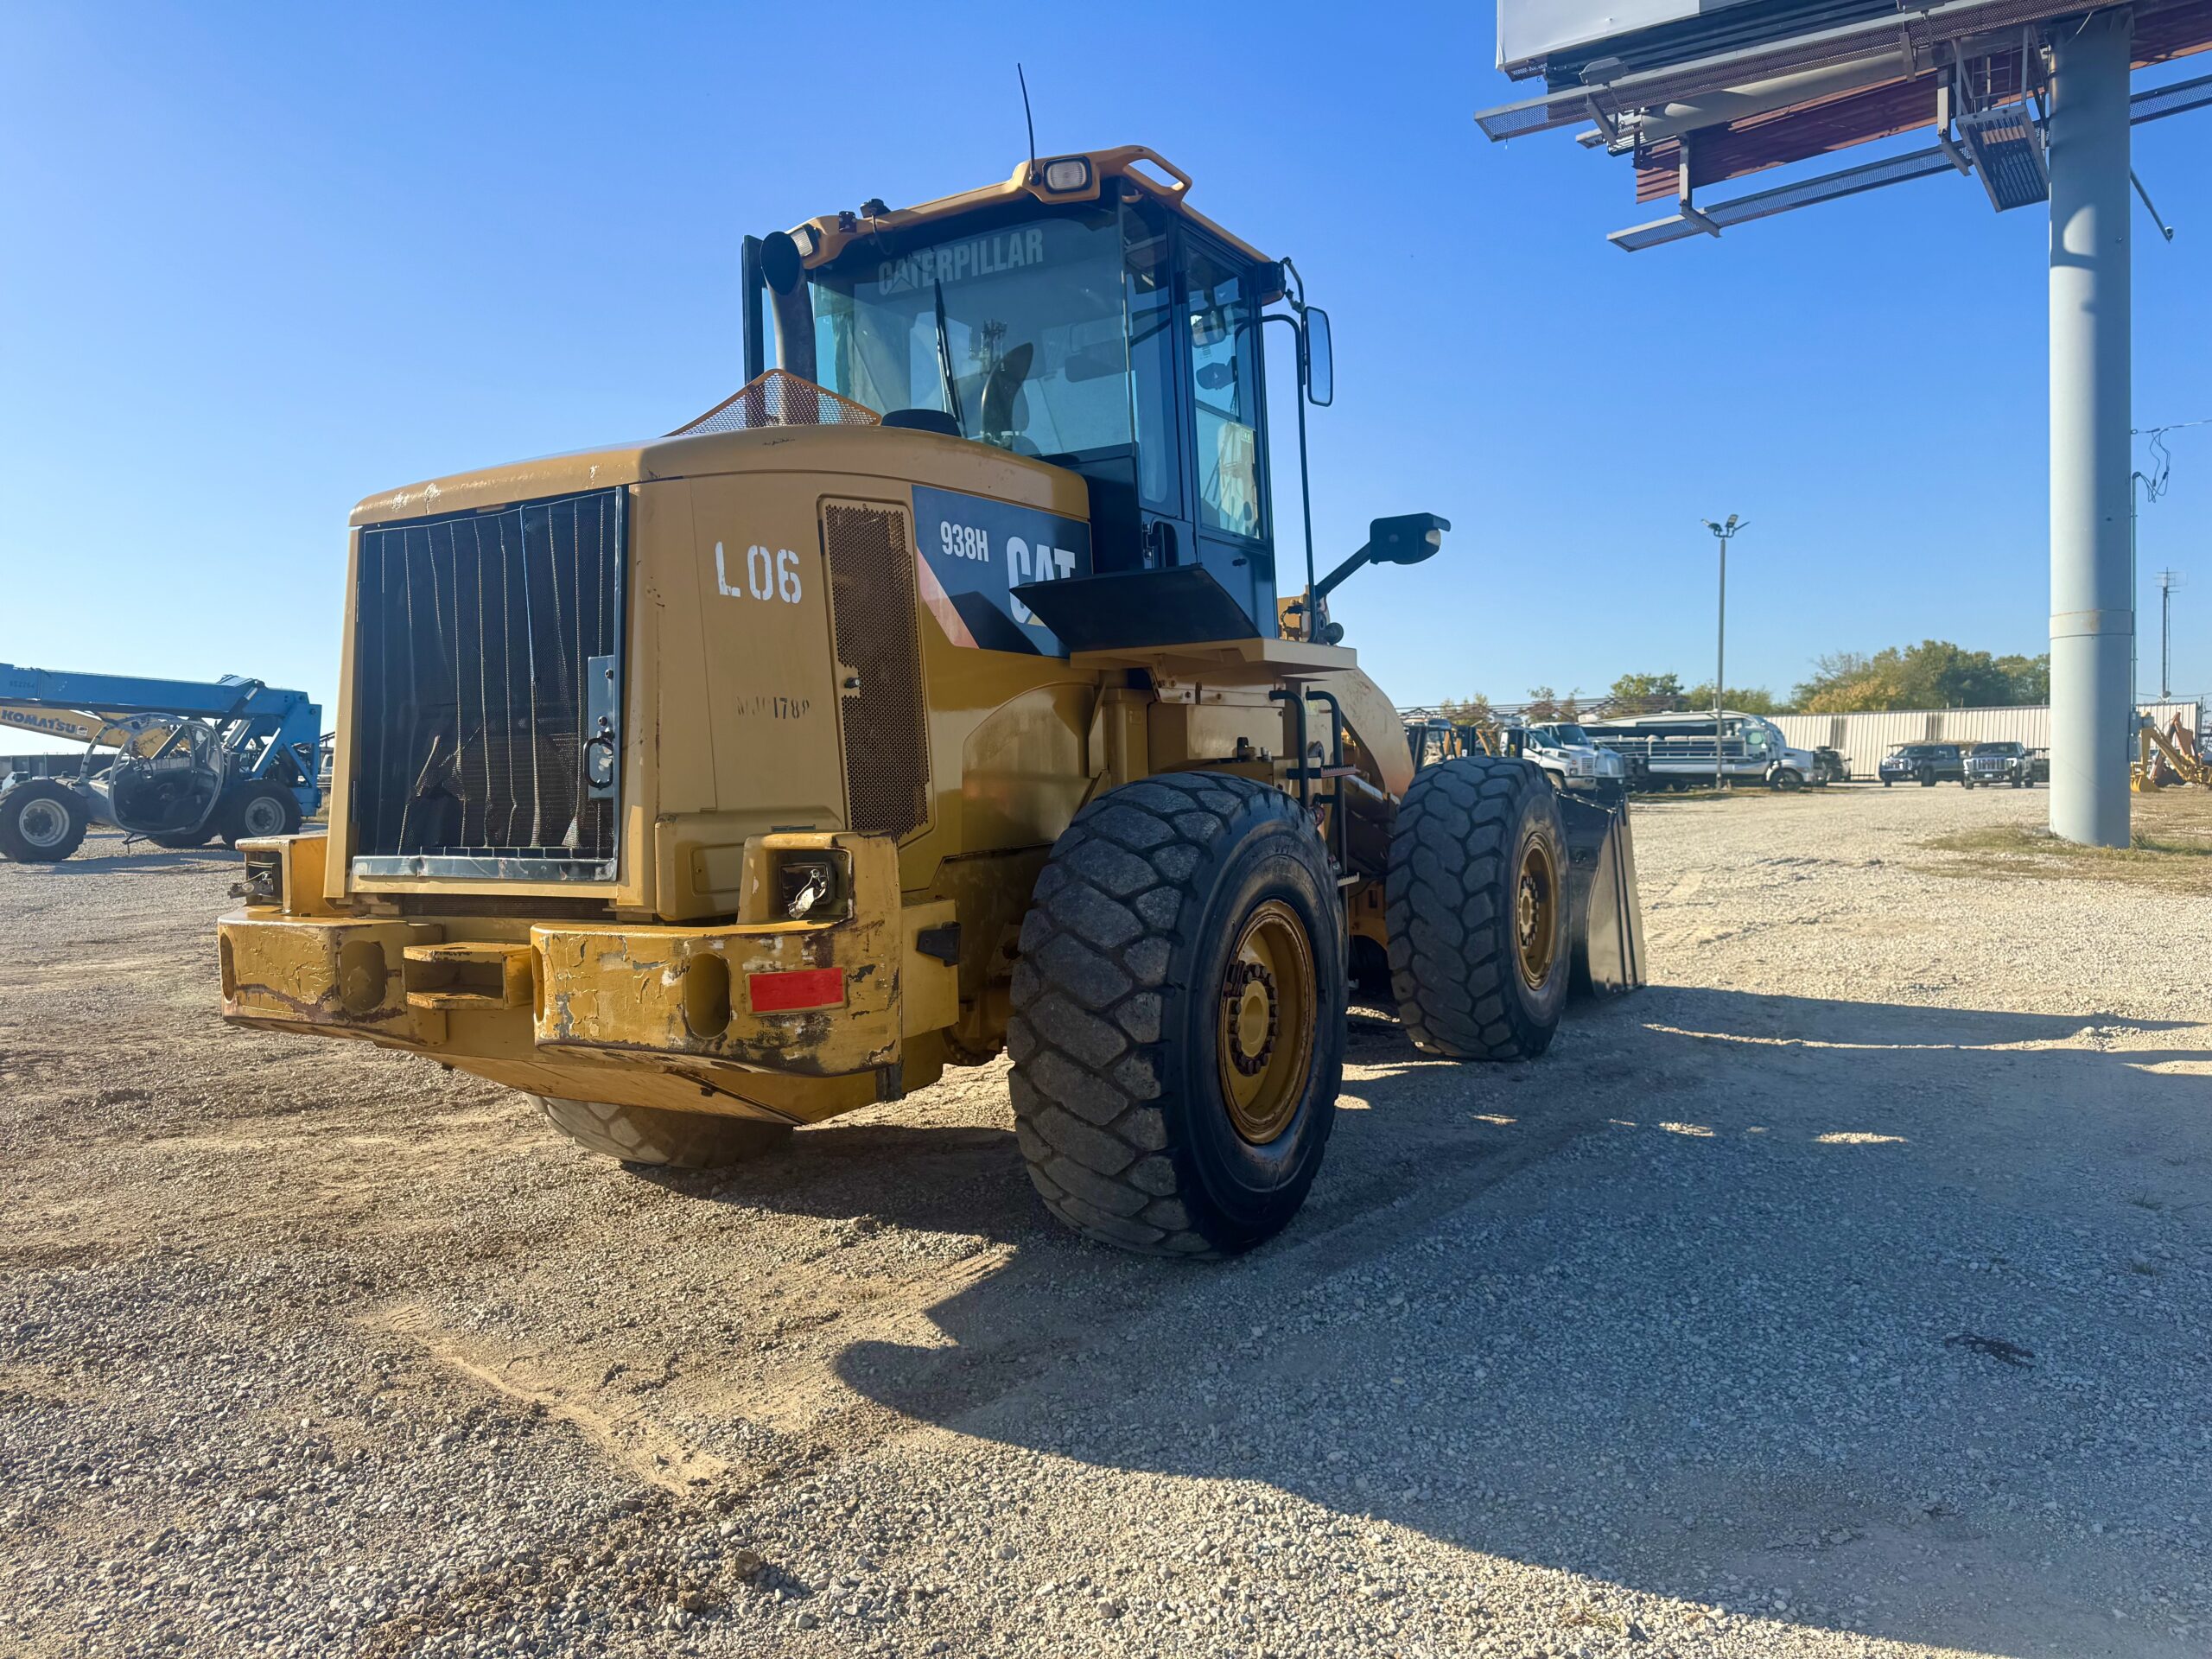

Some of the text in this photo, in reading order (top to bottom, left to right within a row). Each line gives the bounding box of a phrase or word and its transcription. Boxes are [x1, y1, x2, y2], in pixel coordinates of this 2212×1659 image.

[878, 228, 1044, 296] CATERPILLAR
[940, 520, 989, 563] 938H
[1, 709, 76, 734] KOMATSU
